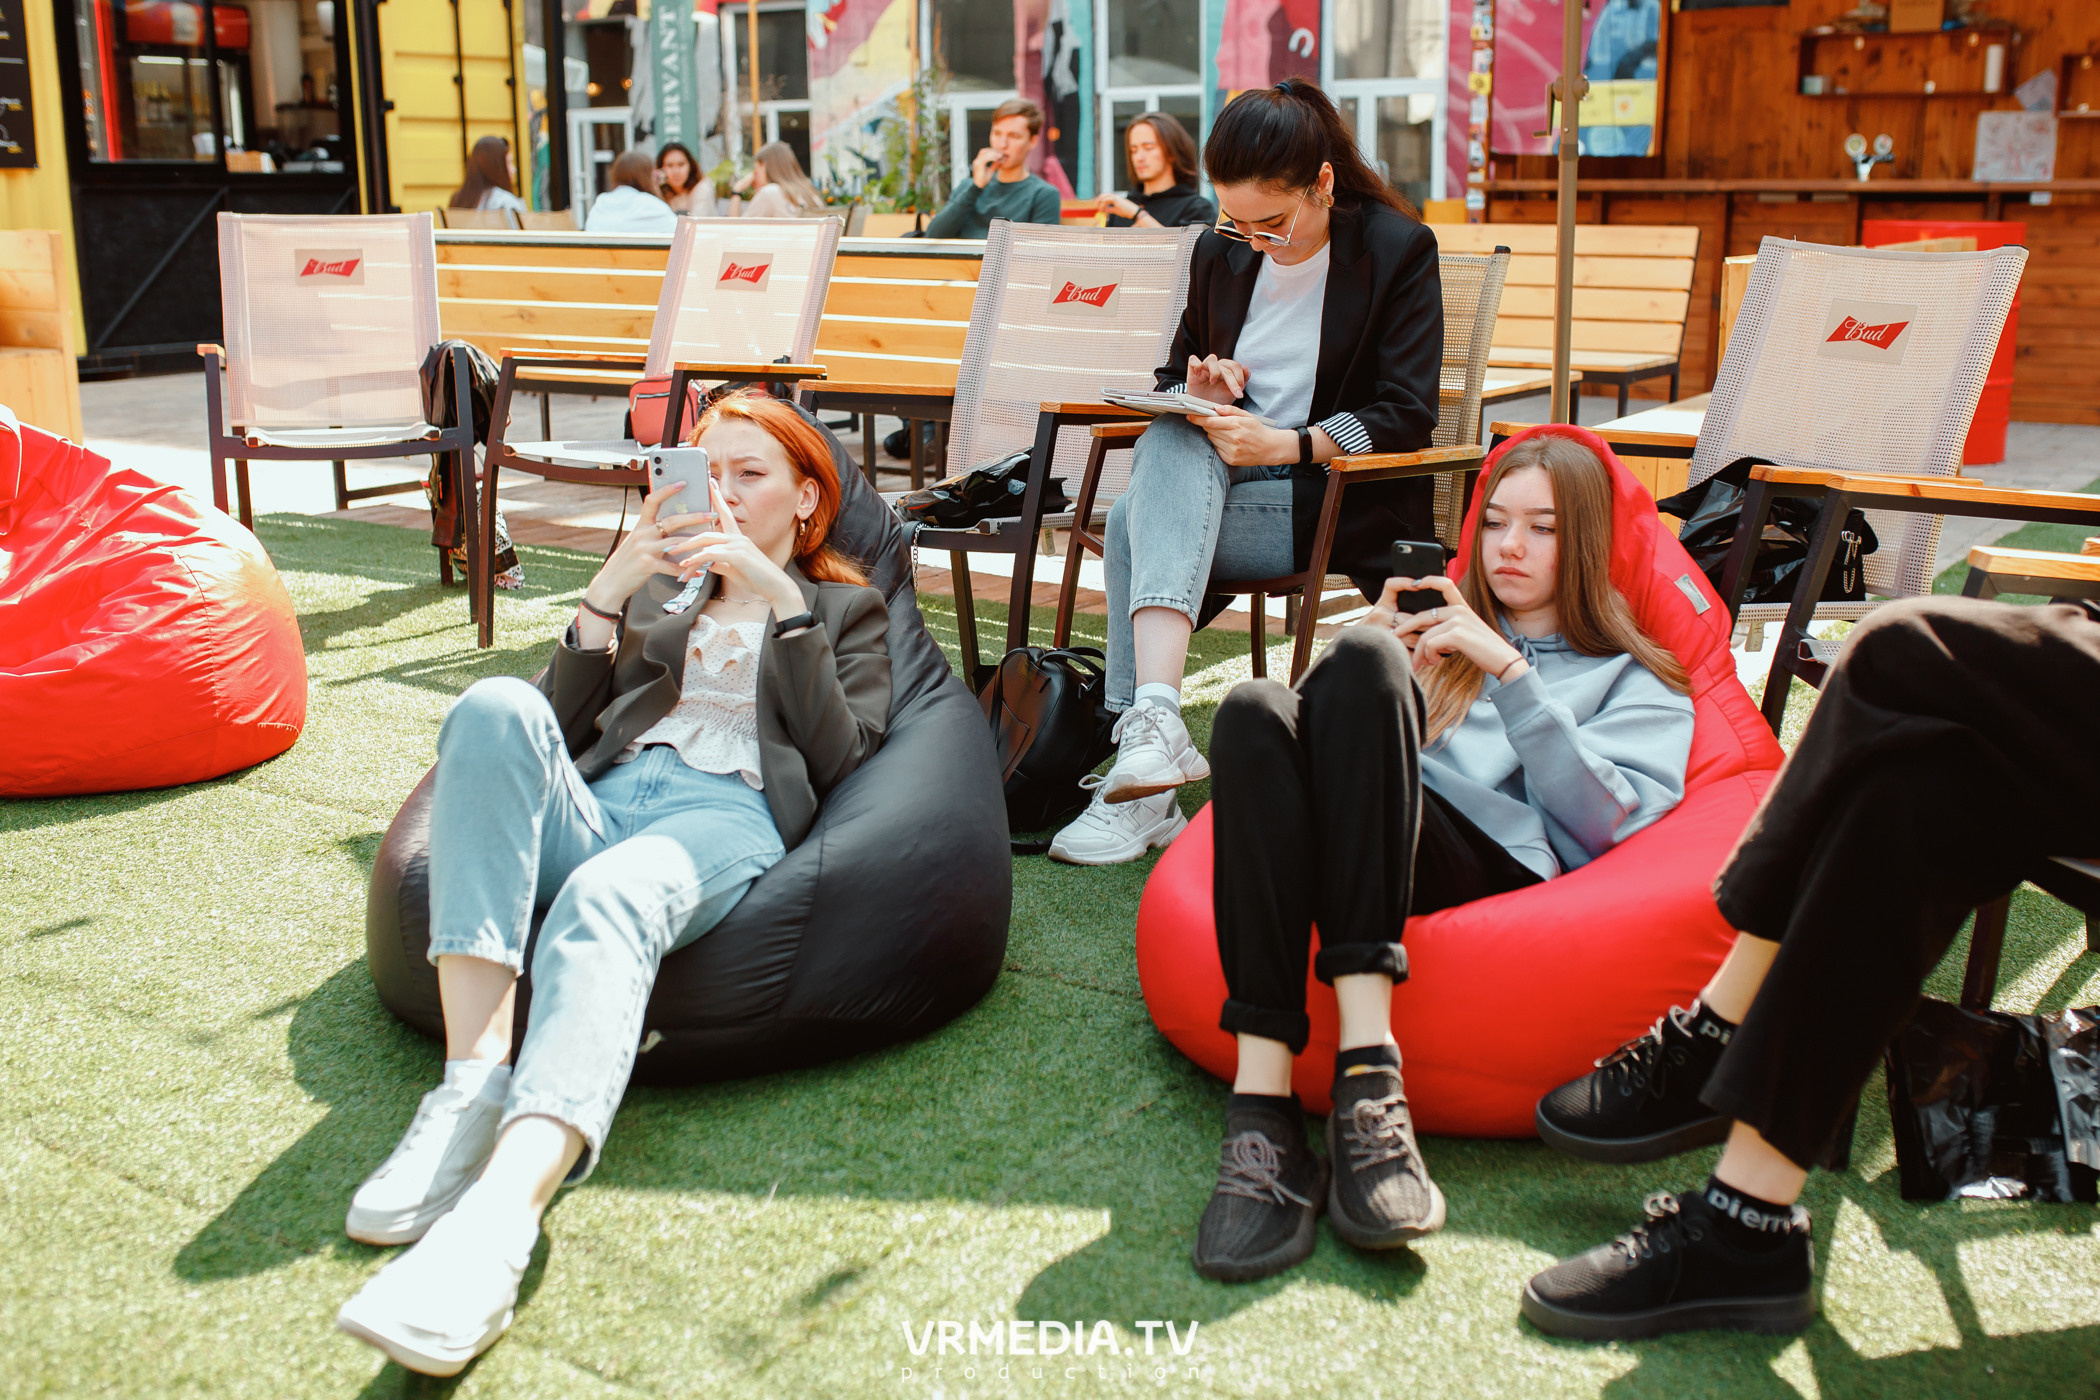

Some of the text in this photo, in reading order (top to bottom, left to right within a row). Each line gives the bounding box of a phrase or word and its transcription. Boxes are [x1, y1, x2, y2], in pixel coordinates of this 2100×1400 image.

[730, 265, 758, 279] Bud
[1065, 284, 1103, 302] Bud
[1844, 320, 1890, 341] Bud
